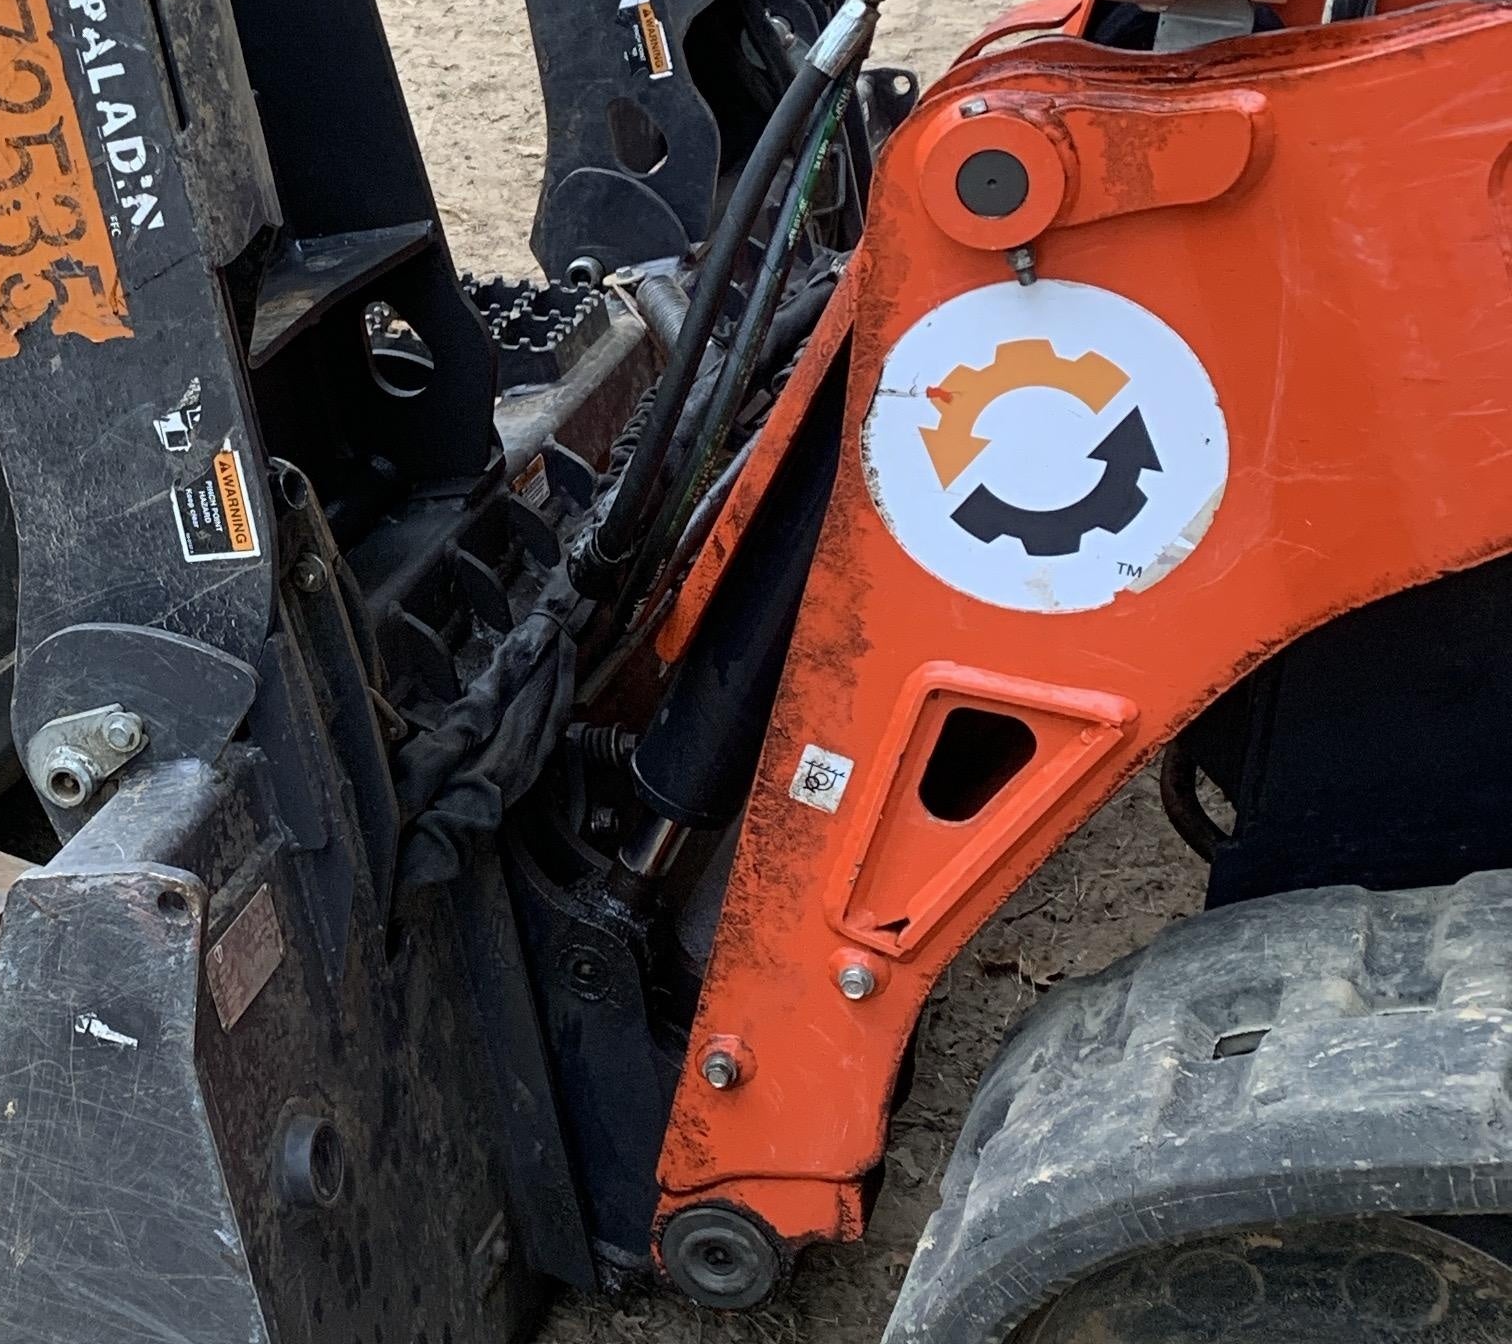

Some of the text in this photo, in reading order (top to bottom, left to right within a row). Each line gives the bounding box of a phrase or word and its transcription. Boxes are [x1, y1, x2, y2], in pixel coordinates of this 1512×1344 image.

[646, 18, 663, 68] WARNING
[185, 488, 195, 509] Keep
[198, 490, 212, 524] HAZARD
[205, 481, 223, 532] PINCH POINT
[223, 474, 247, 545] WARNING
[1116, 561, 1142, 578] TM
